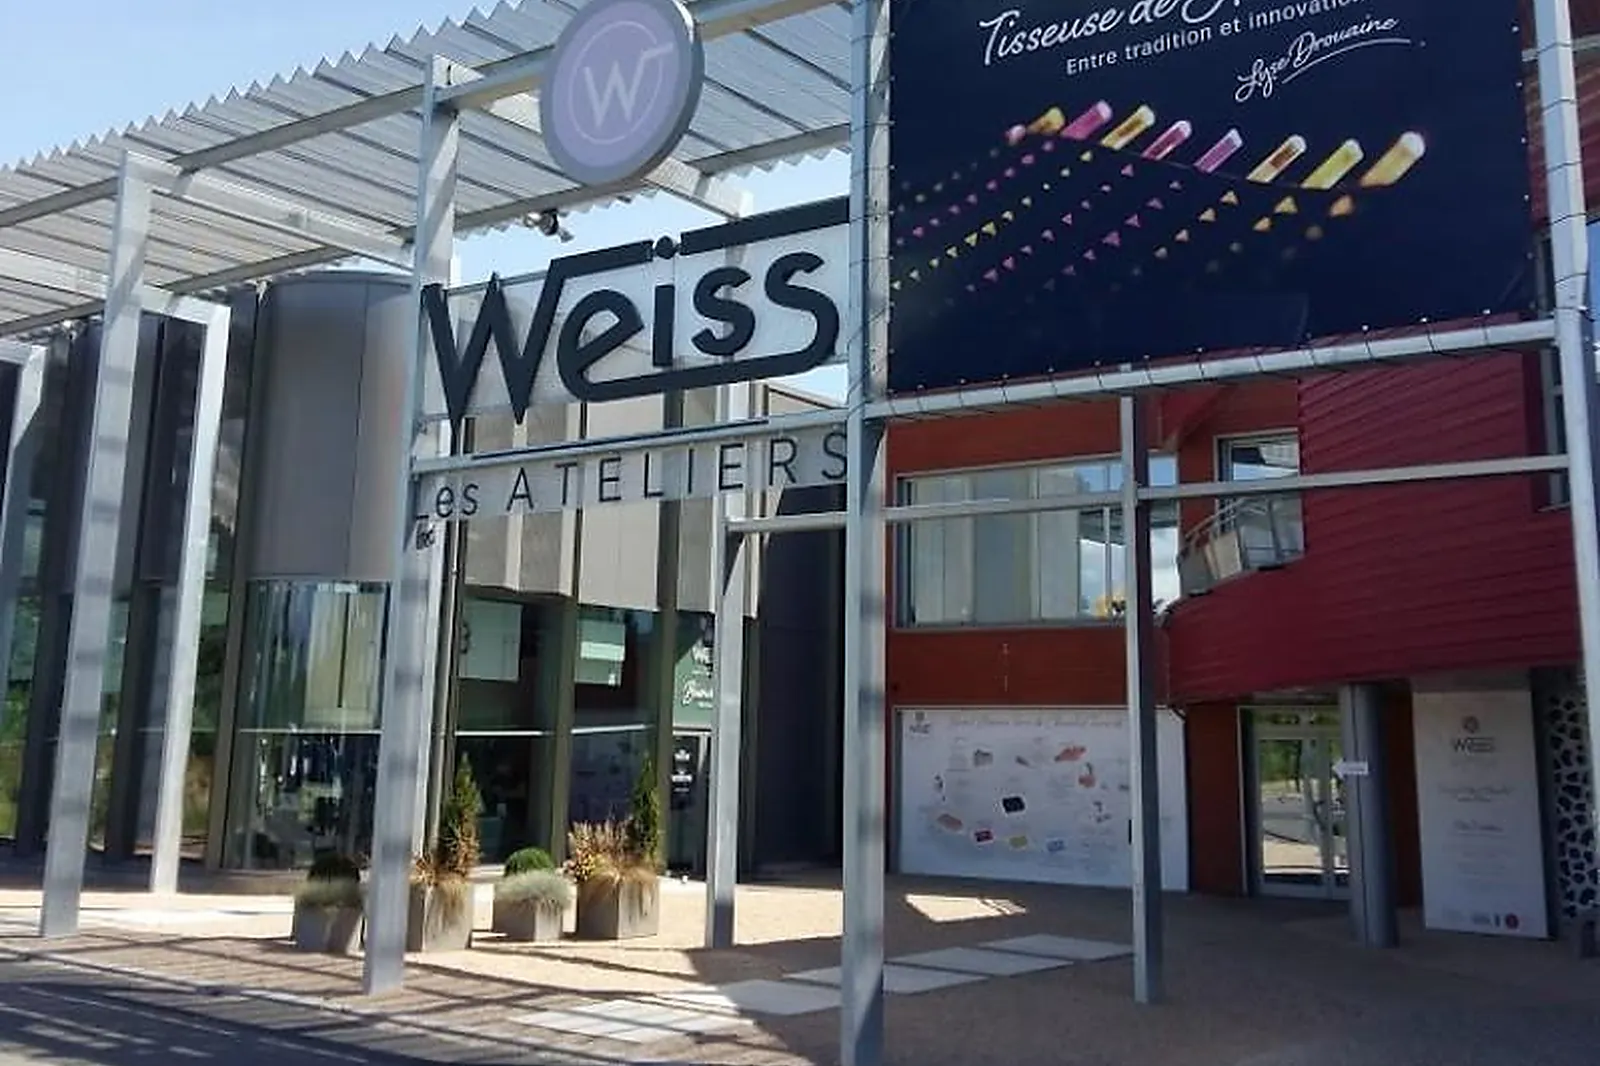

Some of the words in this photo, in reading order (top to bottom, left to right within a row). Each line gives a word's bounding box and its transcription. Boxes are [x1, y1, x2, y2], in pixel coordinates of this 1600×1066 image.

[979, 9, 1125, 65] Tisseuse
[1066, 51, 1117, 75] Entre
[1125, 27, 1212, 60] tradition
[1219, 18, 1241, 36] et
[1249, 0, 1362, 30] innovati
[582, 42, 675, 128] W
[420, 196, 849, 456] Weiss
[415, 483, 479, 518] es
[506, 431, 847, 511] ATELIERS
